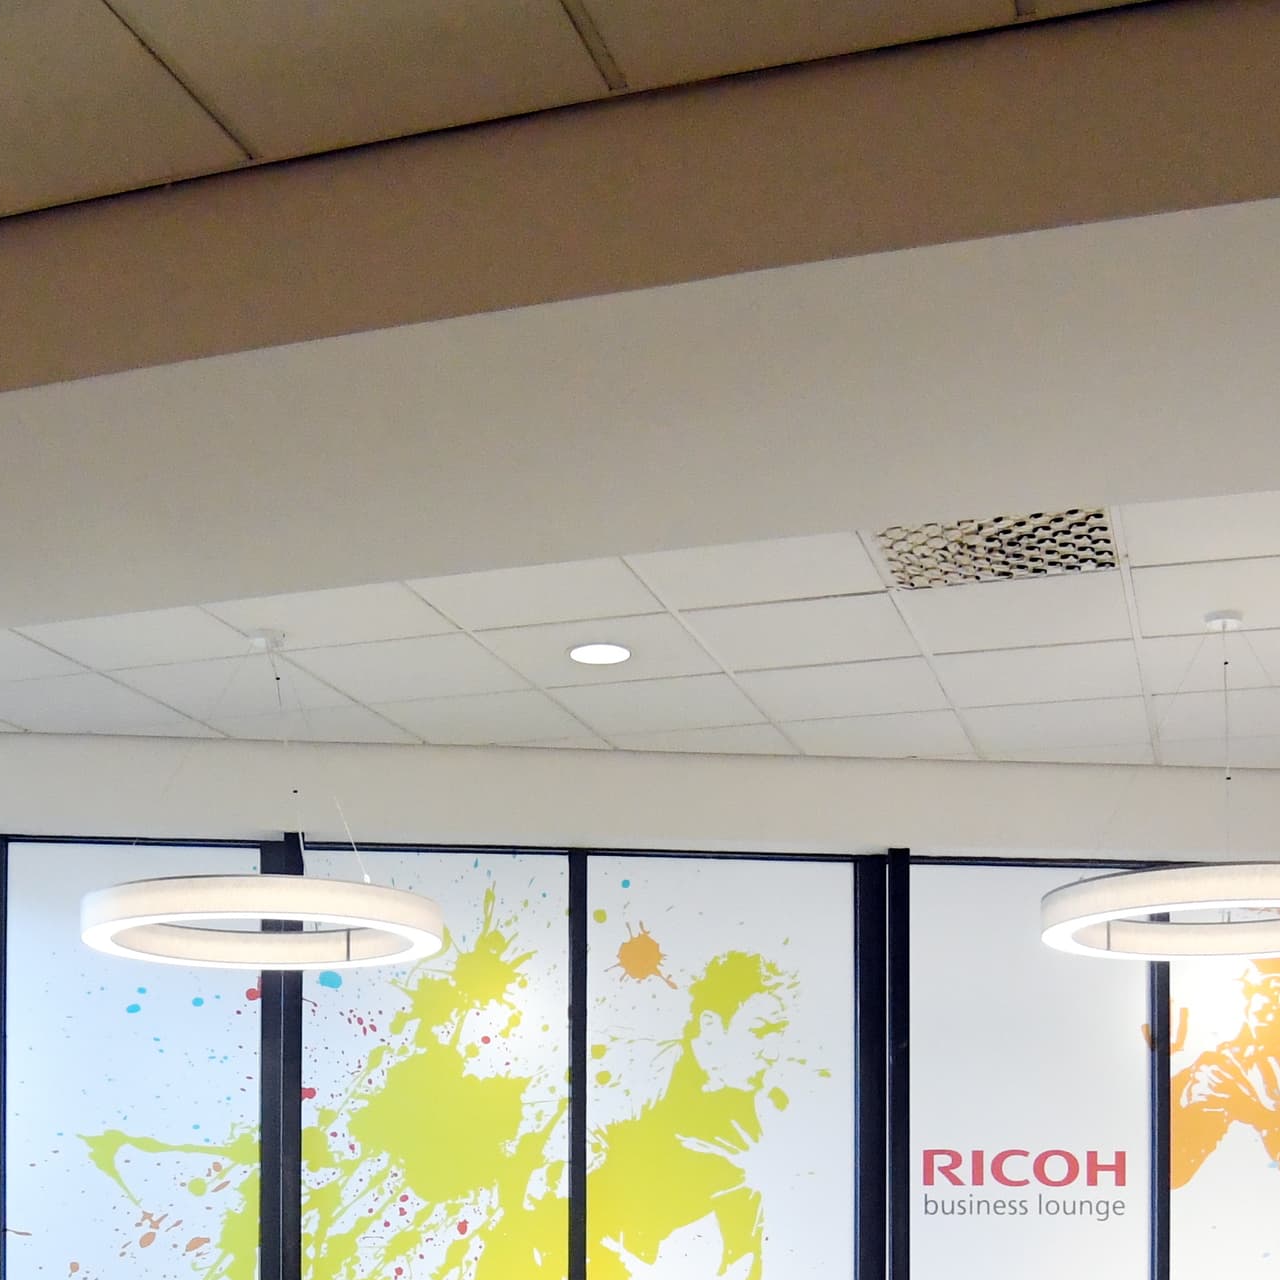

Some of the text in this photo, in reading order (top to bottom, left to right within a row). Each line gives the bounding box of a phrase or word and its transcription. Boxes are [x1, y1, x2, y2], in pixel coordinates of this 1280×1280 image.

[923, 1149, 1126, 1187] RICOH
[924, 1193, 1126, 1222] business lounge
